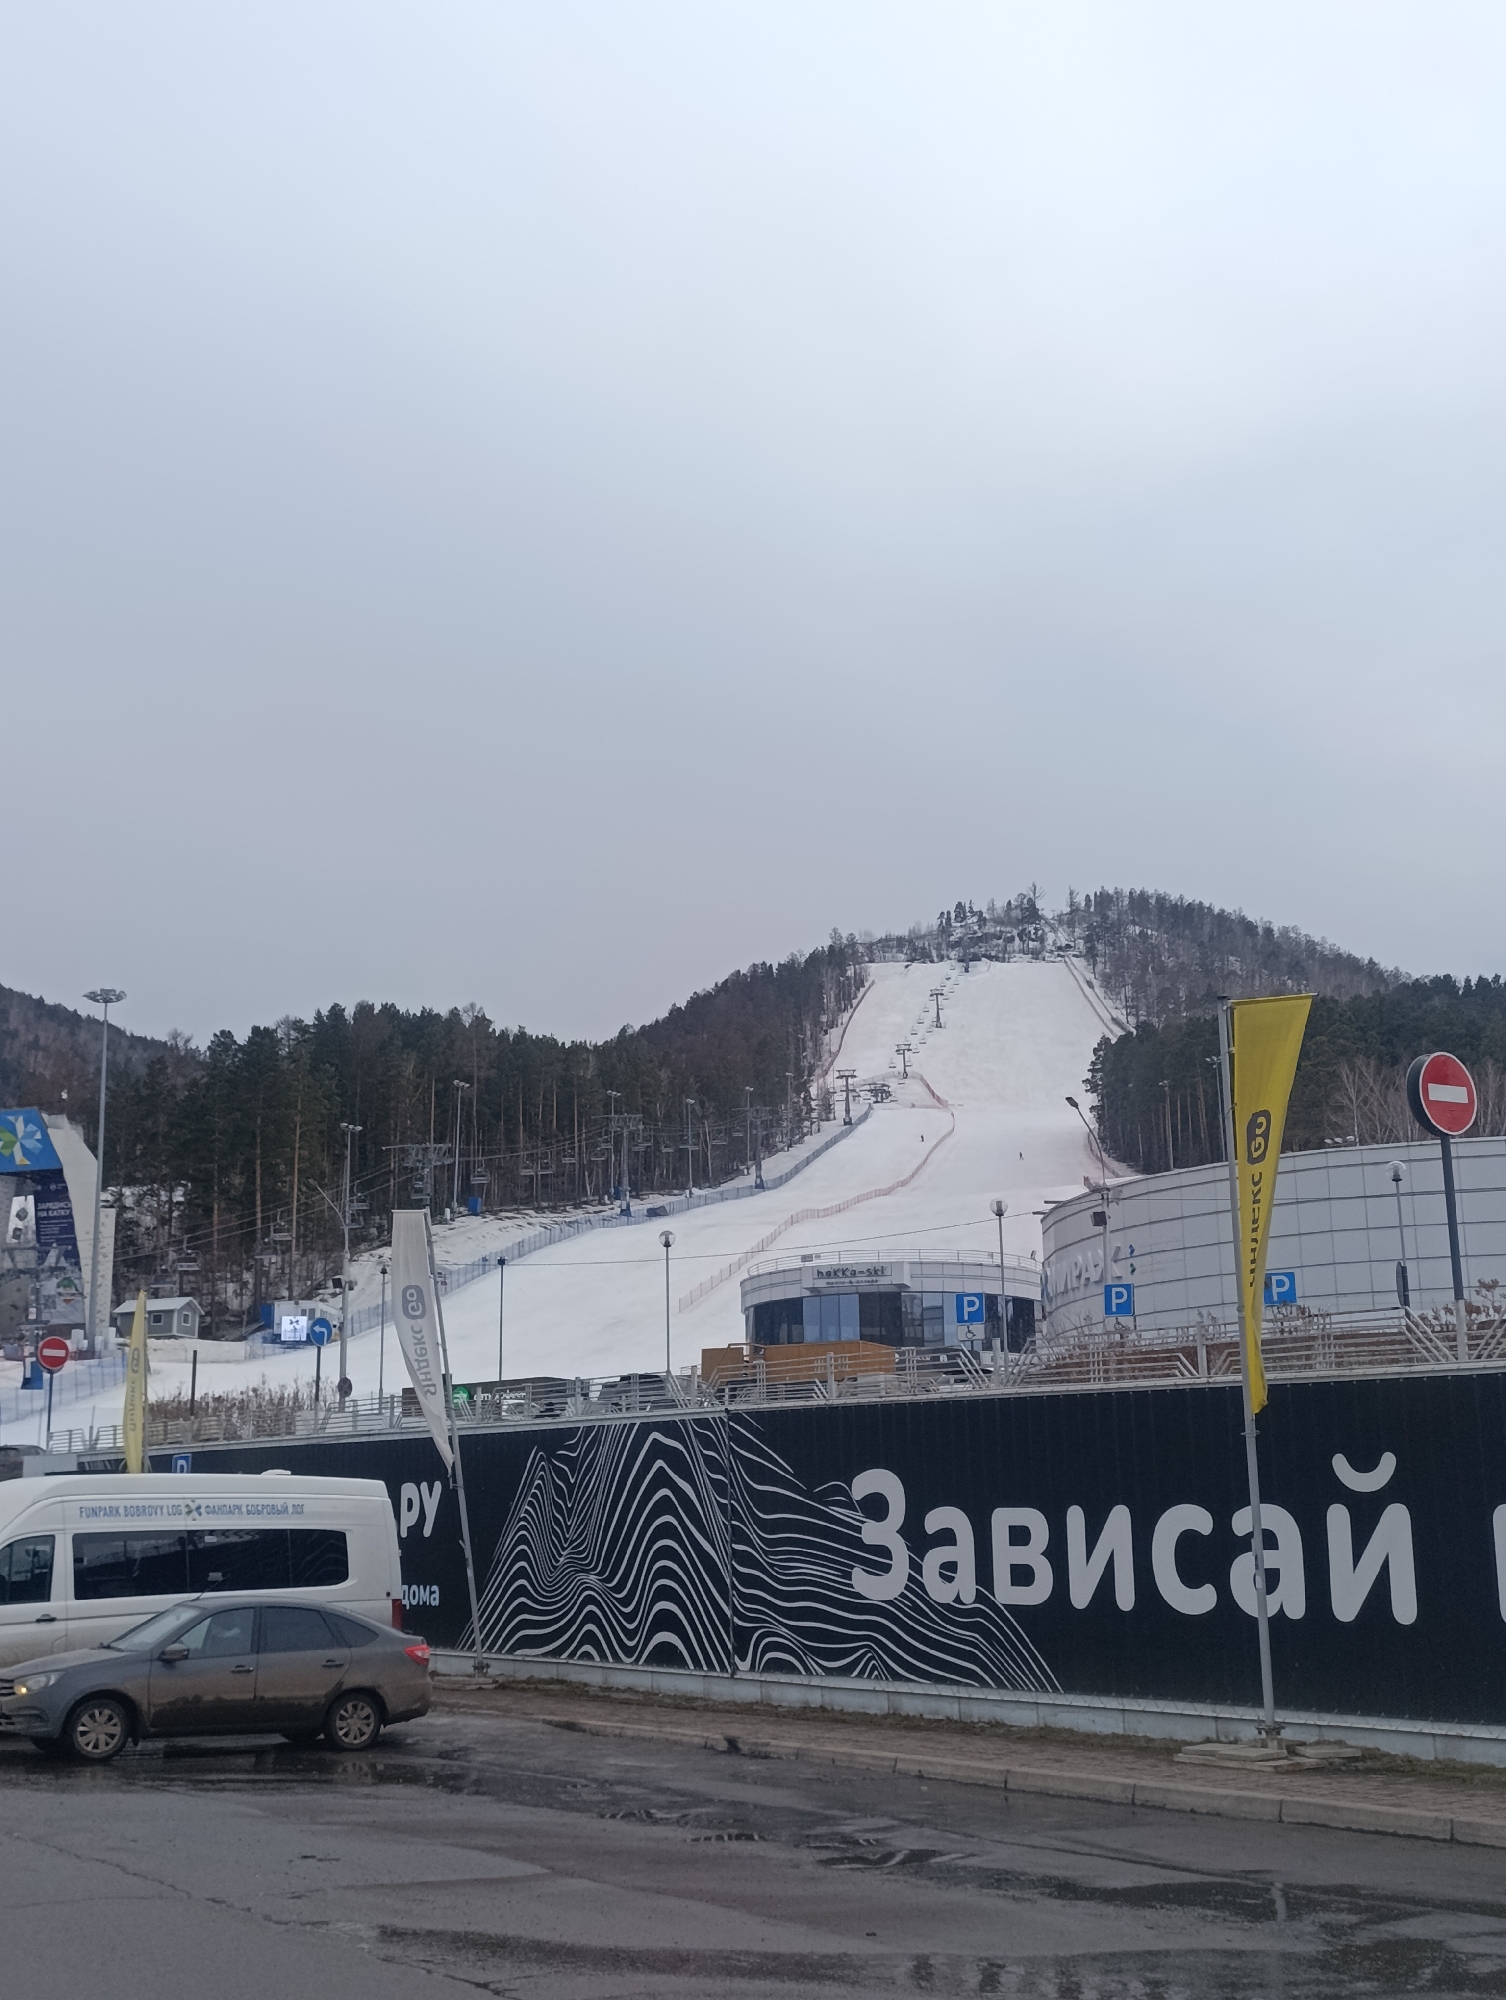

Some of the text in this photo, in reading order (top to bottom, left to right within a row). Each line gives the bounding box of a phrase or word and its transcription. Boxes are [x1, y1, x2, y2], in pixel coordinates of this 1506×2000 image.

[1111, 1287, 1128, 1312] P
[1272, 1275, 1291, 1301] P
[963, 1296, 980, 1320] P
[79, 1504, 182, 1518] FUNPARK BOBROVY LOG
[205, 1502, 305, 1516] ФАНПАРК БОБРОВЫЙ ЛОГ
[851, 1450, 1418, 1626] Зависай
